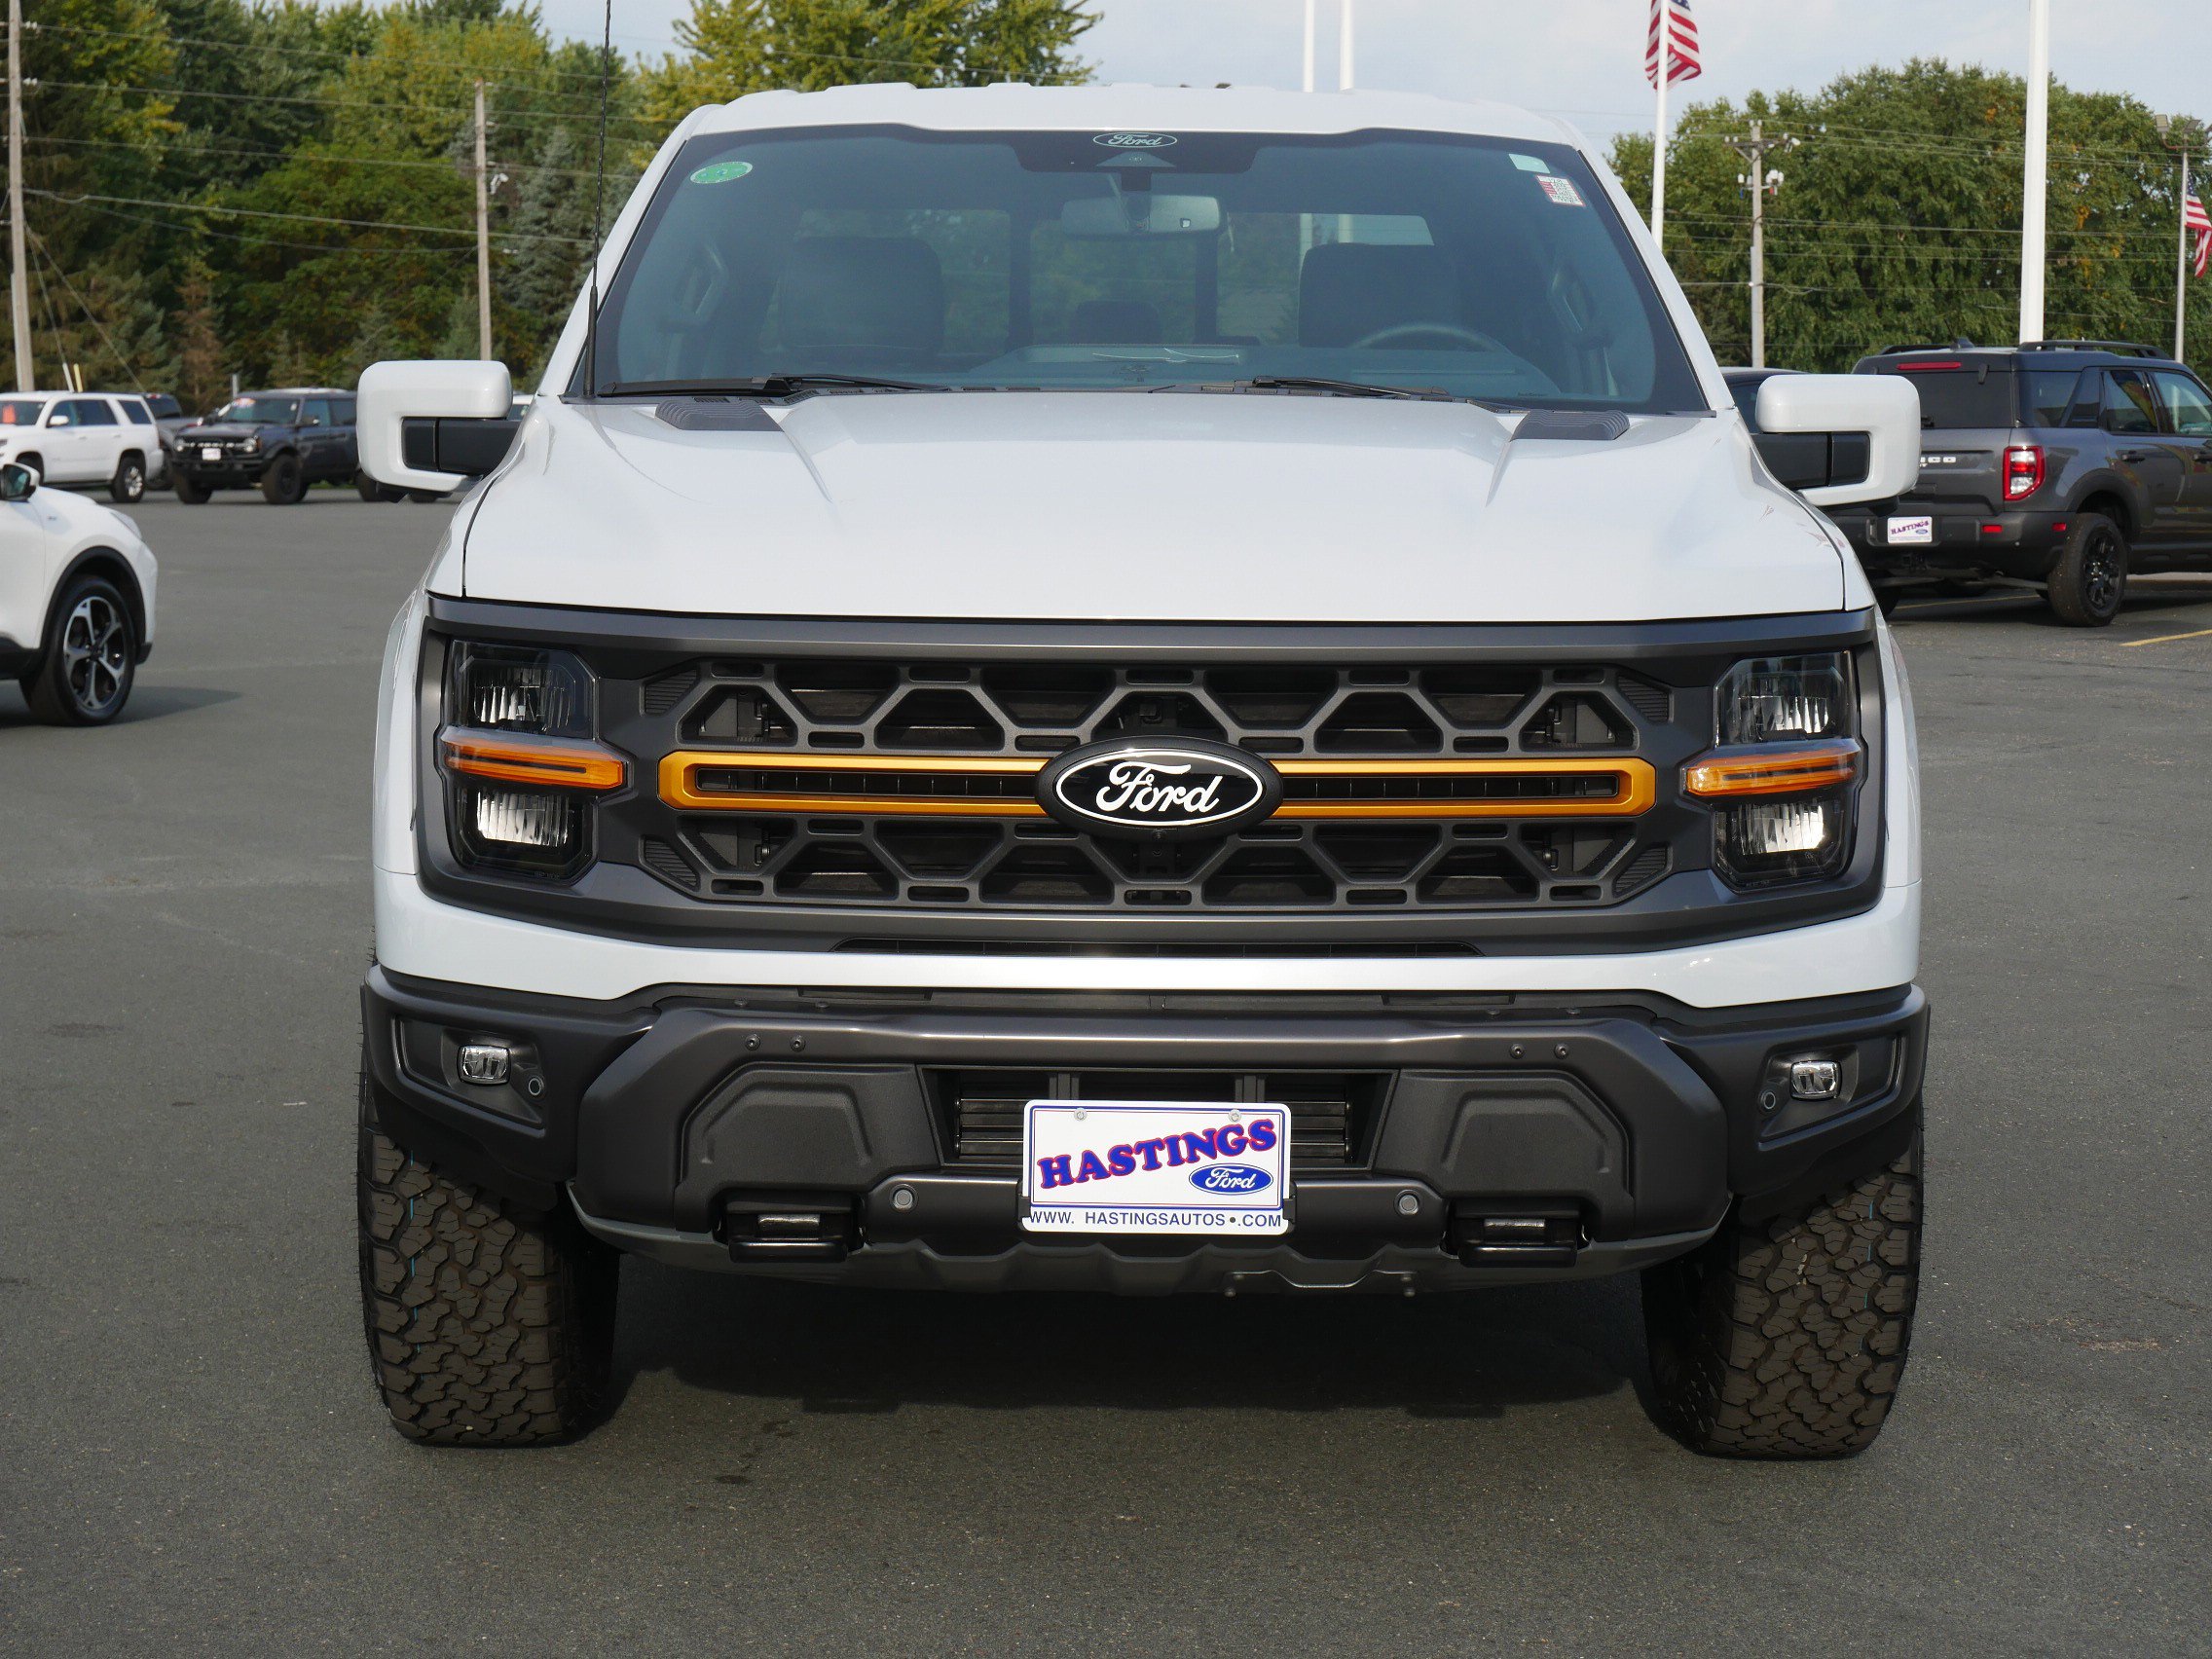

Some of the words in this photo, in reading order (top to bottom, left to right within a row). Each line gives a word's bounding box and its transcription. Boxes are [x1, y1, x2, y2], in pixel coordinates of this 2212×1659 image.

[1108, 133, 1162, 146] Ford
[1891, 520, 1930, 535] HASTINGS
[1096, 761, 1224, 812] Ford
[1037, 1119, 1277, 1190] HASTINGS
[1204, 1166, 1256, 1190] Ford
